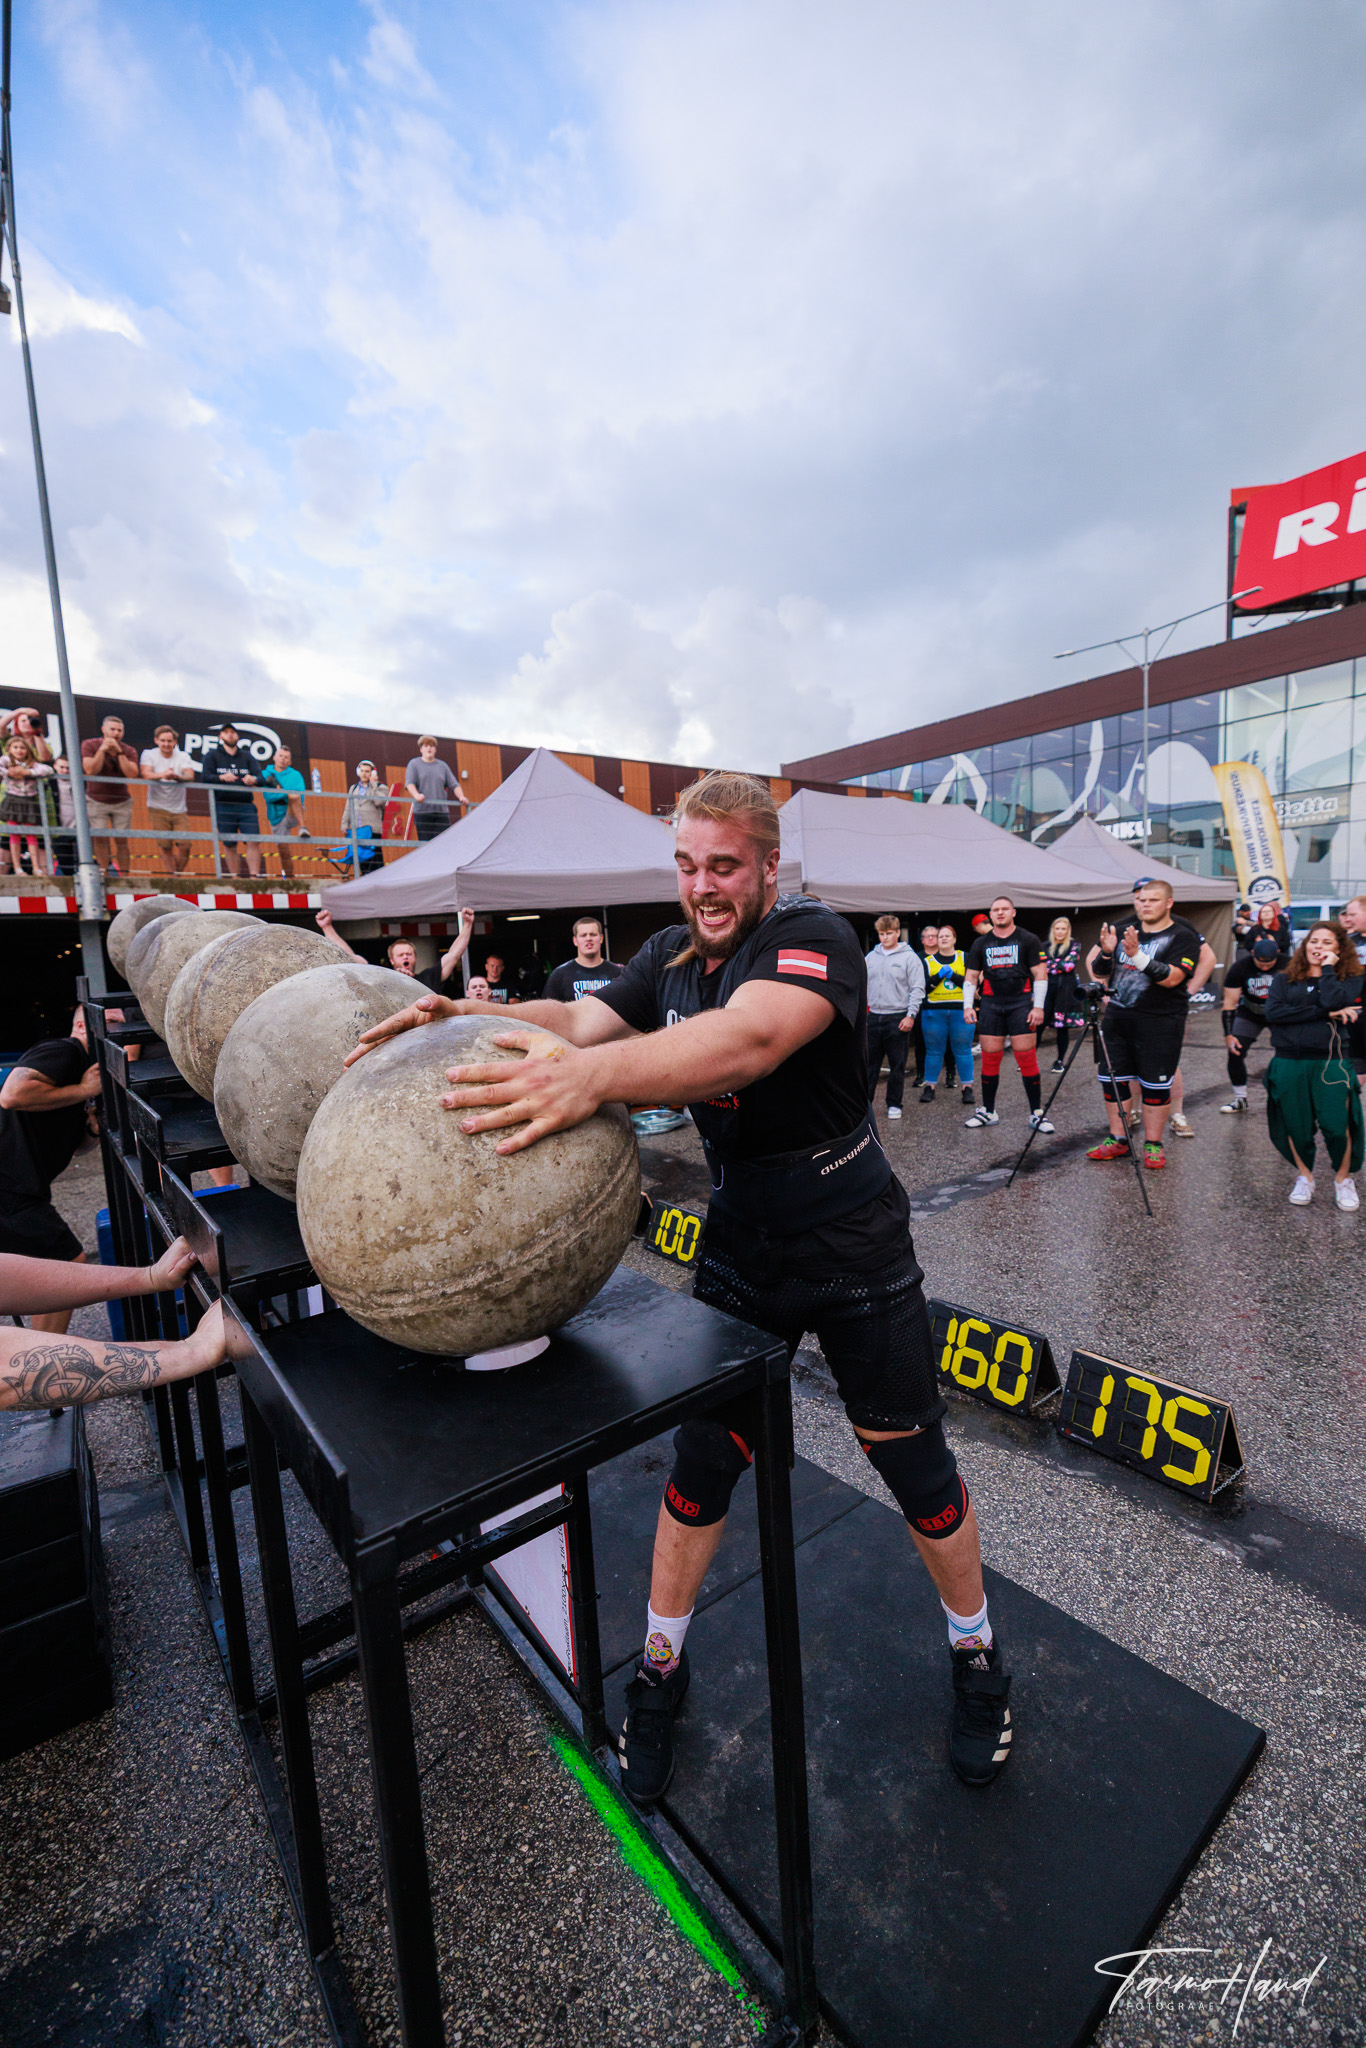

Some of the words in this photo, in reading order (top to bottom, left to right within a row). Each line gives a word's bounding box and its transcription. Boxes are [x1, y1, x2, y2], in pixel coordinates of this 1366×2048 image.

[184, 733, 274, 761] PECO
[654, 1208, 701, 1262] 100
[941, 1318, 1033, 1406] 160
[1092, 1374, 1211, 1486] 175
[669, 1486, 697, 1514] SBD
[919, 1509, 956, 1529] SBD
